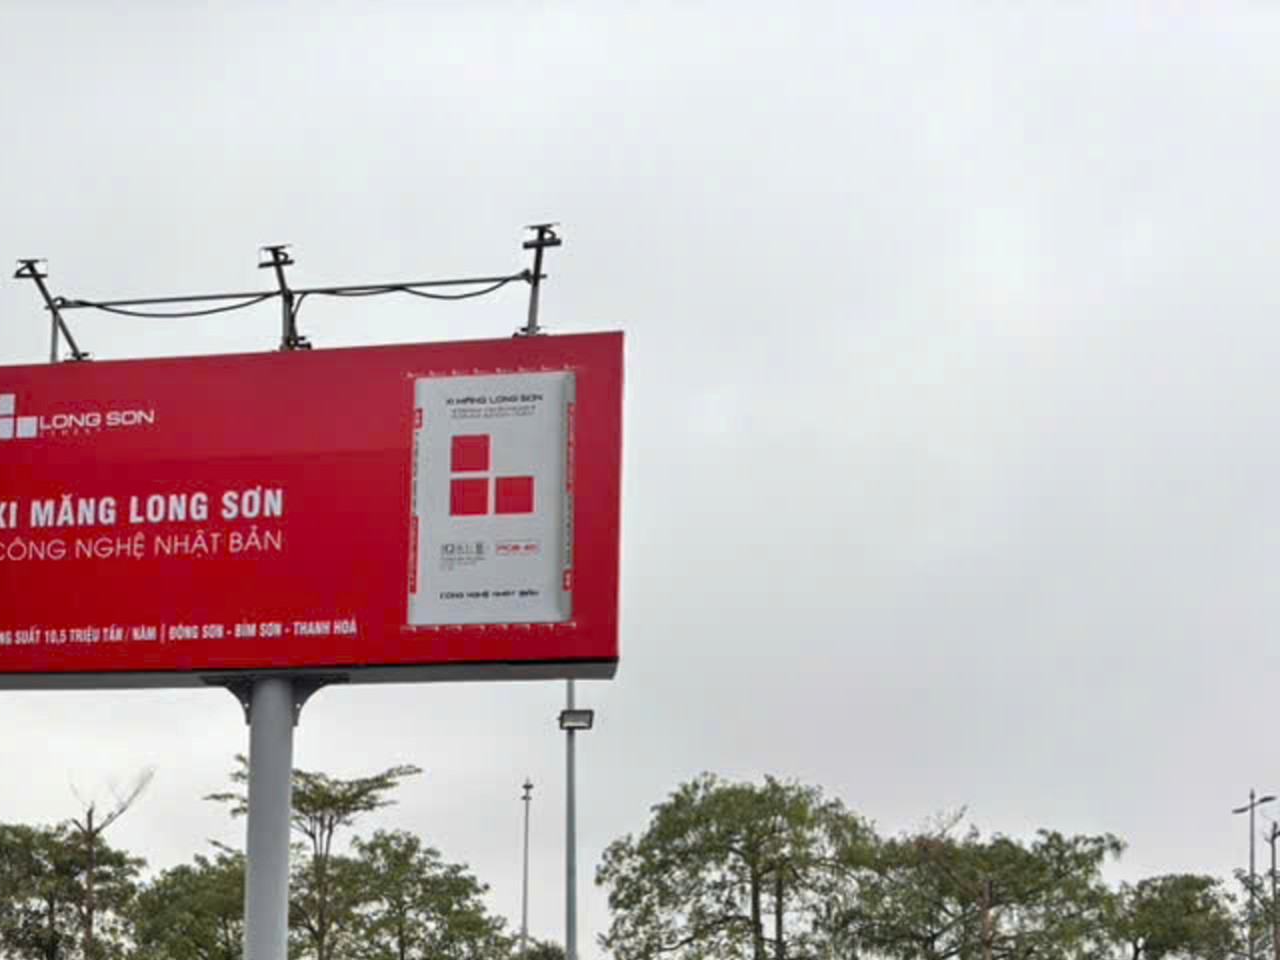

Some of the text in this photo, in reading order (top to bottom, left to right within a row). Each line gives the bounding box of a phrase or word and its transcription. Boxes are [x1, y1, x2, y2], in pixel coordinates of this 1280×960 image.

[39, 413, 101, 430] LONG
[30, 494, 117, 527] MĂNG
[128, 492, 208, 523] LONG
[221, 485, 283, 520] SƠN
[75, 532, 145, 560] NGHỆ
[154, 530, 221, 558] NHẬT
[229, 525, 282, 553] BẢN
